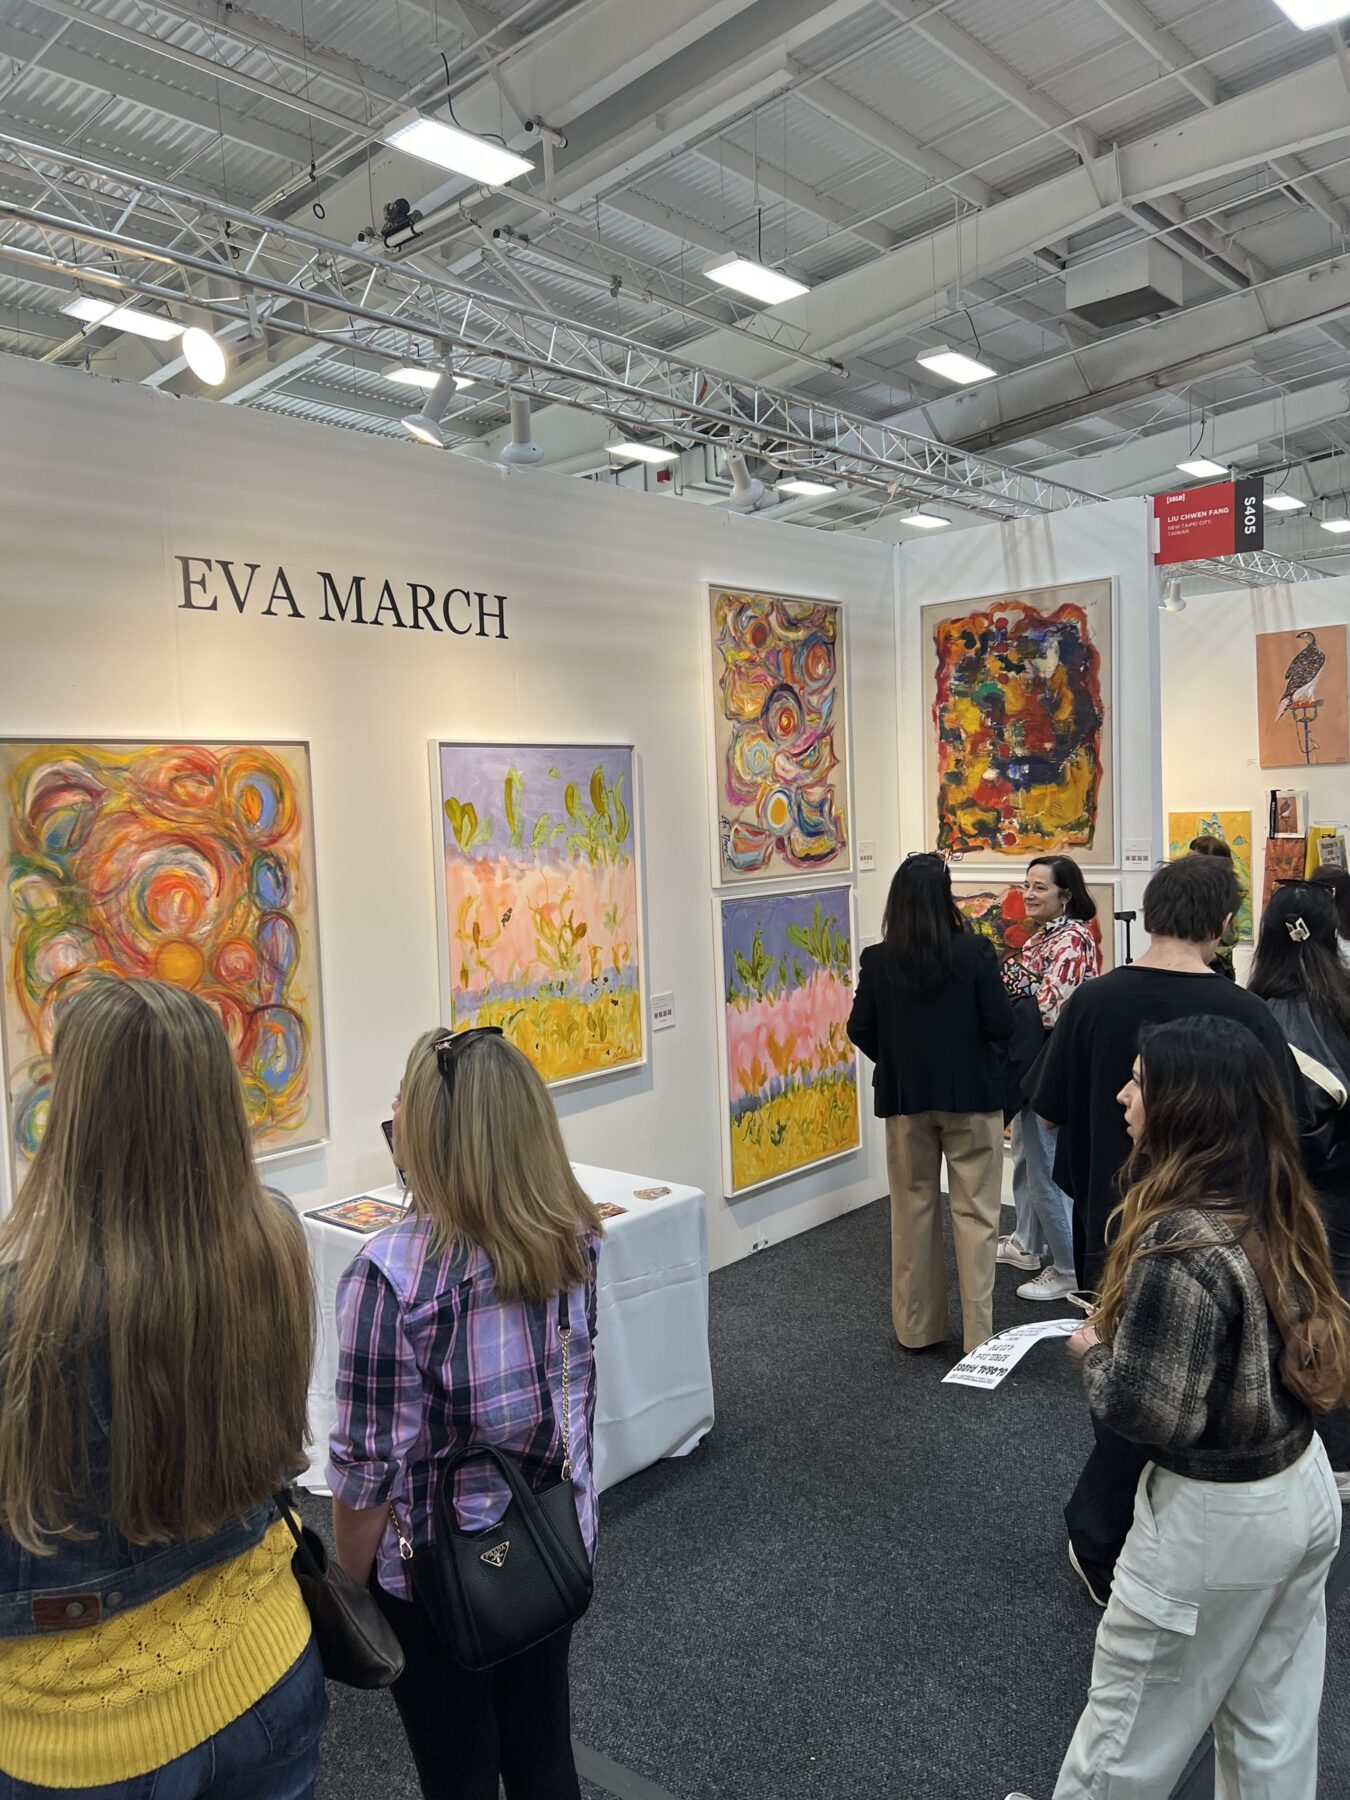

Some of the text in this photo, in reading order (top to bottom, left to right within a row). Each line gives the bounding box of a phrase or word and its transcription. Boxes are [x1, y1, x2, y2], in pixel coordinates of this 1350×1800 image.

[1167, 507, 1229, 523] LIU CHWEN FANG
[1244, 496, 1256, 534] S405
[174, 555, 509, 639] EVA MARCH
[976, 1365, 1009, 1377] GLOBAL
